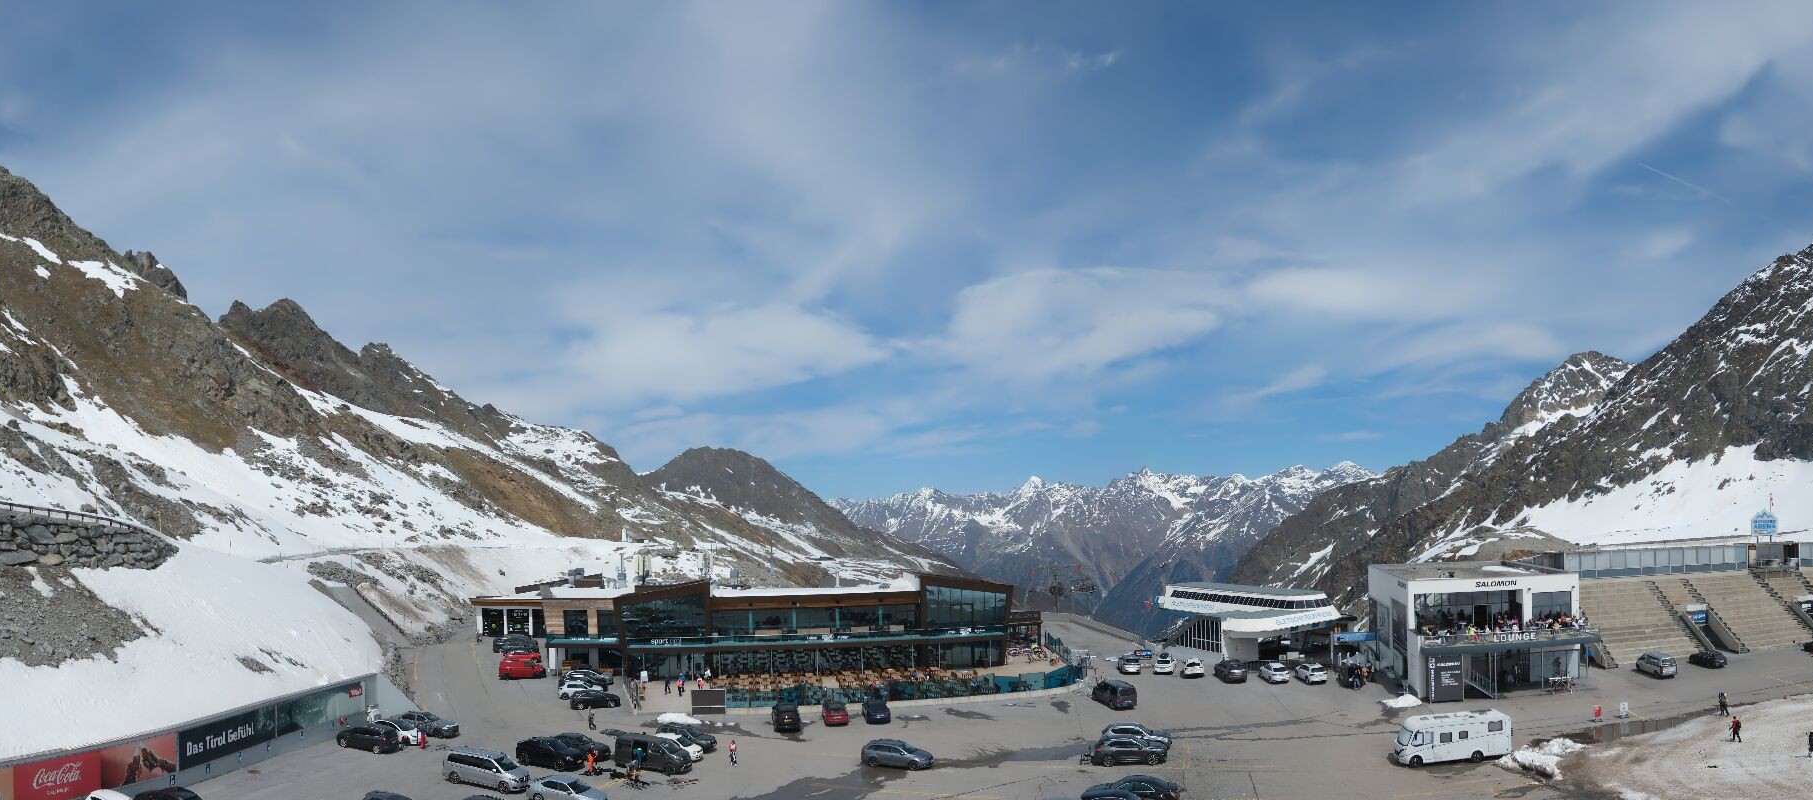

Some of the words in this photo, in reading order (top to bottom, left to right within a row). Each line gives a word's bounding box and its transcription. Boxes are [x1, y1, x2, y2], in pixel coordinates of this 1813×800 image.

[1475, 580, 1517, 588] SALOMON
[1493, 632, 1537, 642] LOUNGE
[650, 638, 668, 646] sport
[186, 741, 204, 757] Das
[205, 734, 226, 749] Tirol
[227, 722, 255, 743] Gefühl
